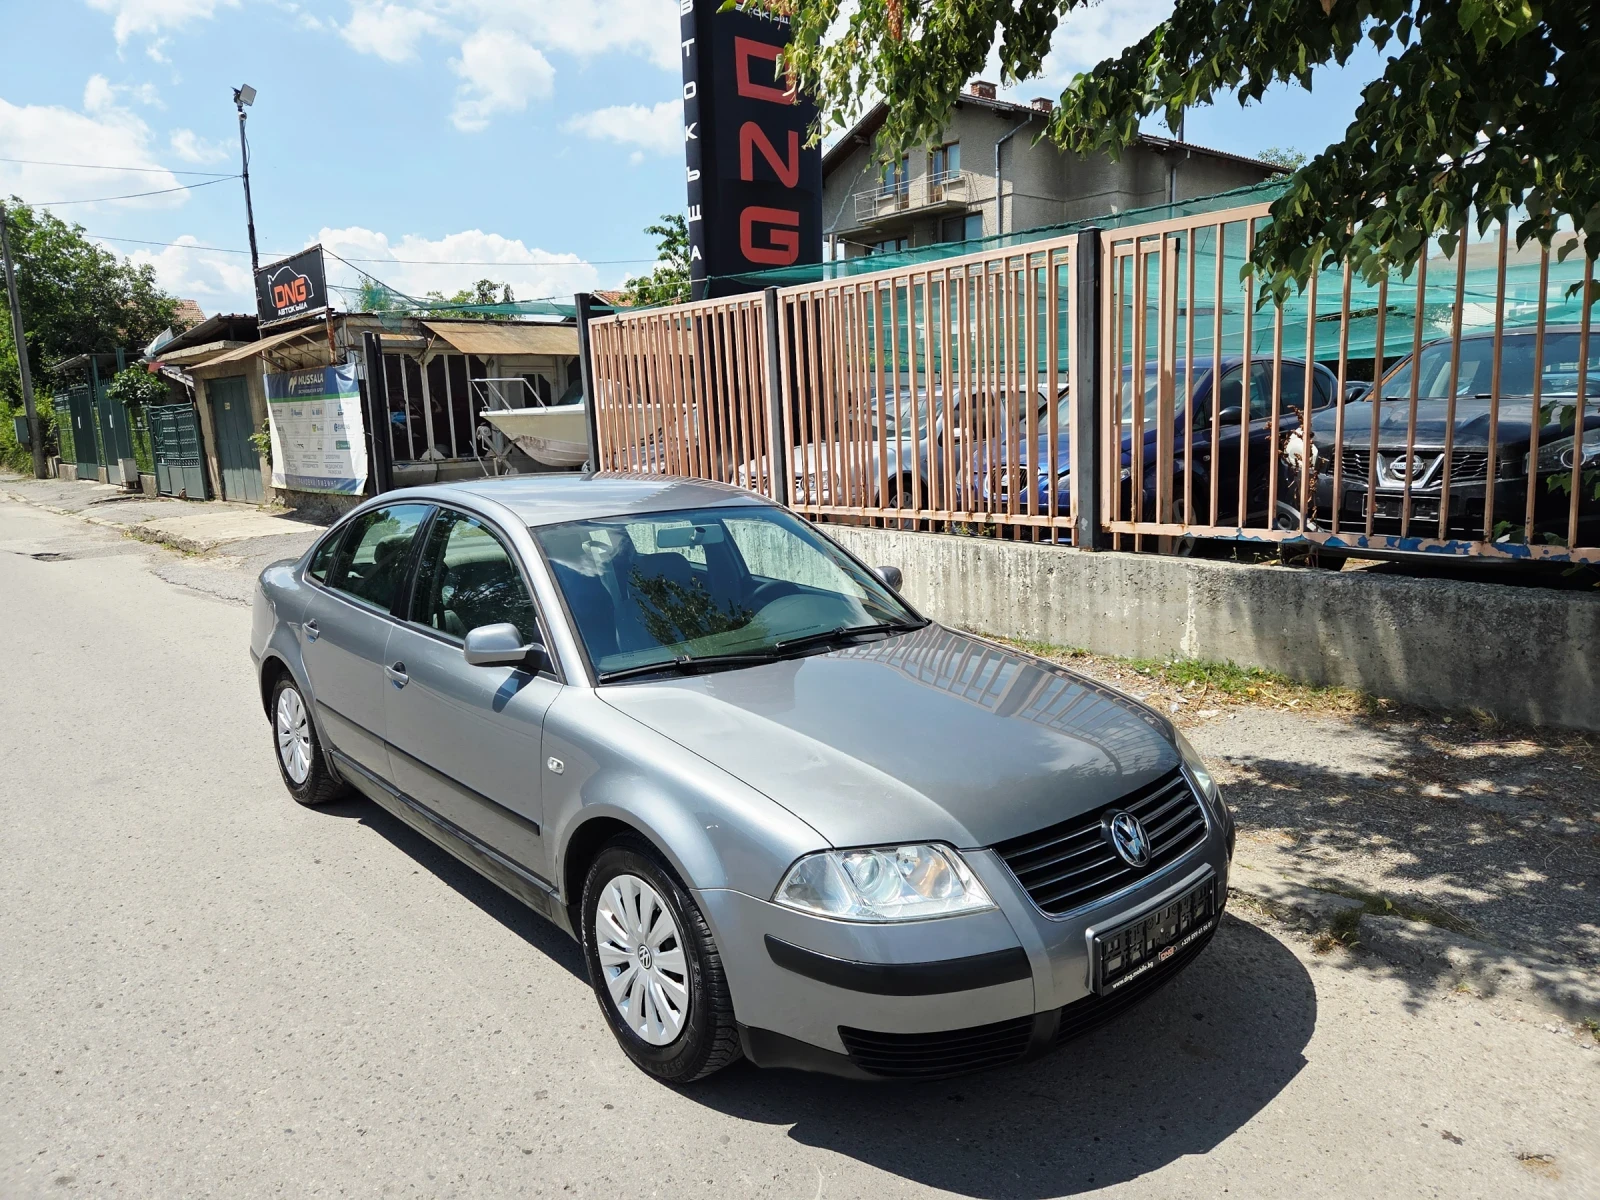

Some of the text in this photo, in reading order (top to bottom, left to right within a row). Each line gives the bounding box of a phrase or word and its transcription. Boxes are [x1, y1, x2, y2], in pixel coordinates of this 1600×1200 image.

[734, 35, 799, 266] DNG
[274, 277, 307, 309] DNG
[298, 372, 324, 385] MUSSALA
